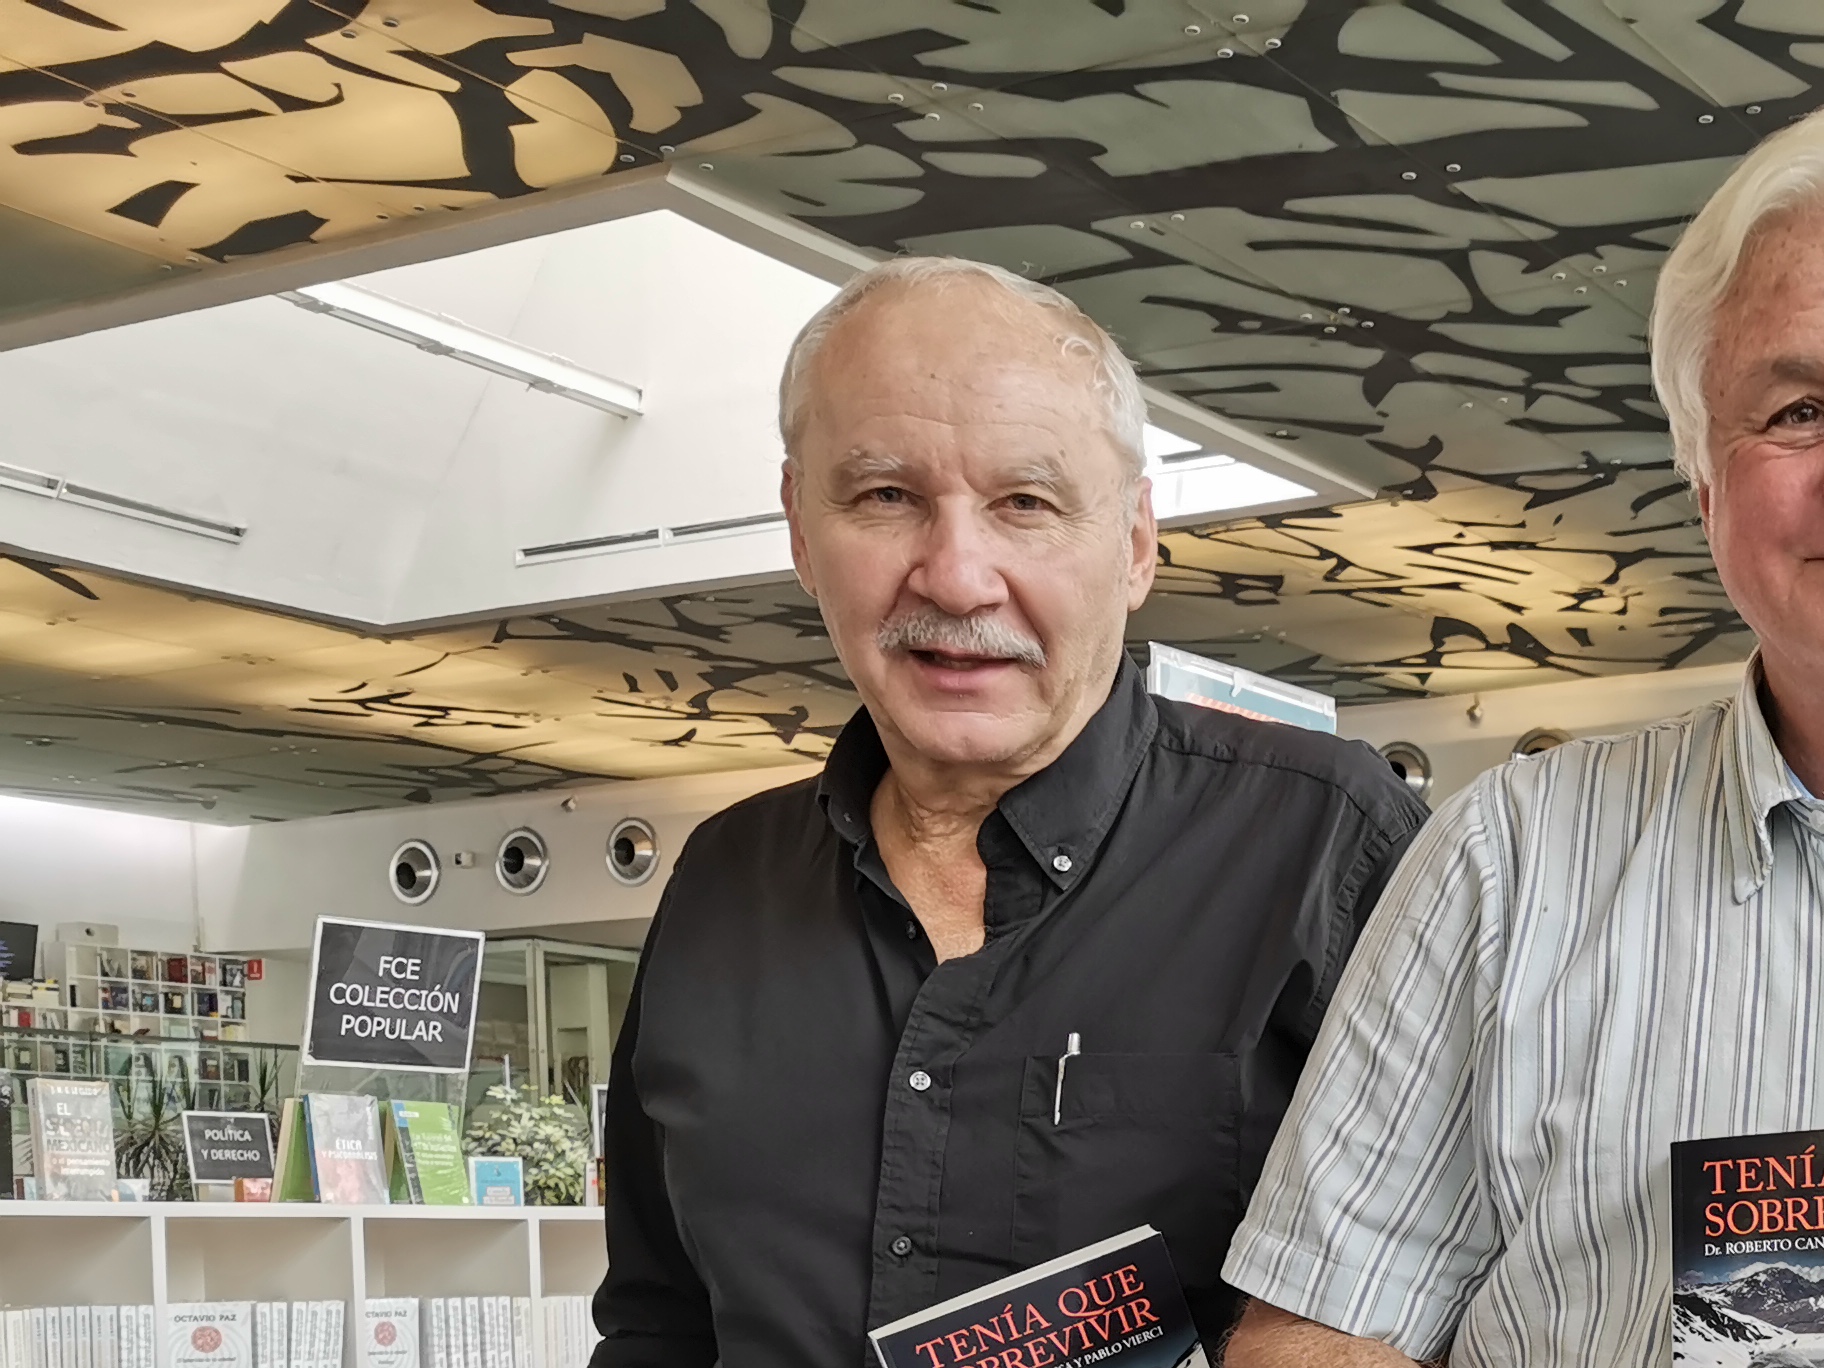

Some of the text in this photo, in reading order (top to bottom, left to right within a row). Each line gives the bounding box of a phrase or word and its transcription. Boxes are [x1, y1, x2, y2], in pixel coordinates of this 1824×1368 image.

[378, 955, 422, 980] FCE
[329, 982, 460, 1014] COLECCIÓN
[340, 1014, 444, 1043] POPULAR
[56, 1102, 72, 1116] EL
[204, 1126, 253, 1142] POLÍTICA
[201, 1149, 261, 1162] Y DERECHO
[1704, 1243, 1722, 1257] Dr.
[1725, 1237, 1792, 1255] ROBERTO
[1057, 1264, 1145, 1318] QUE
[174, 1313, 238, 1323] OCTAVIO PAZ
[364, 1310, 393, 1319] CTAVIO
[1084, 1342, 1123, 1366] PABLO
[1121, 1325, 1164, 1349] VIERCI
